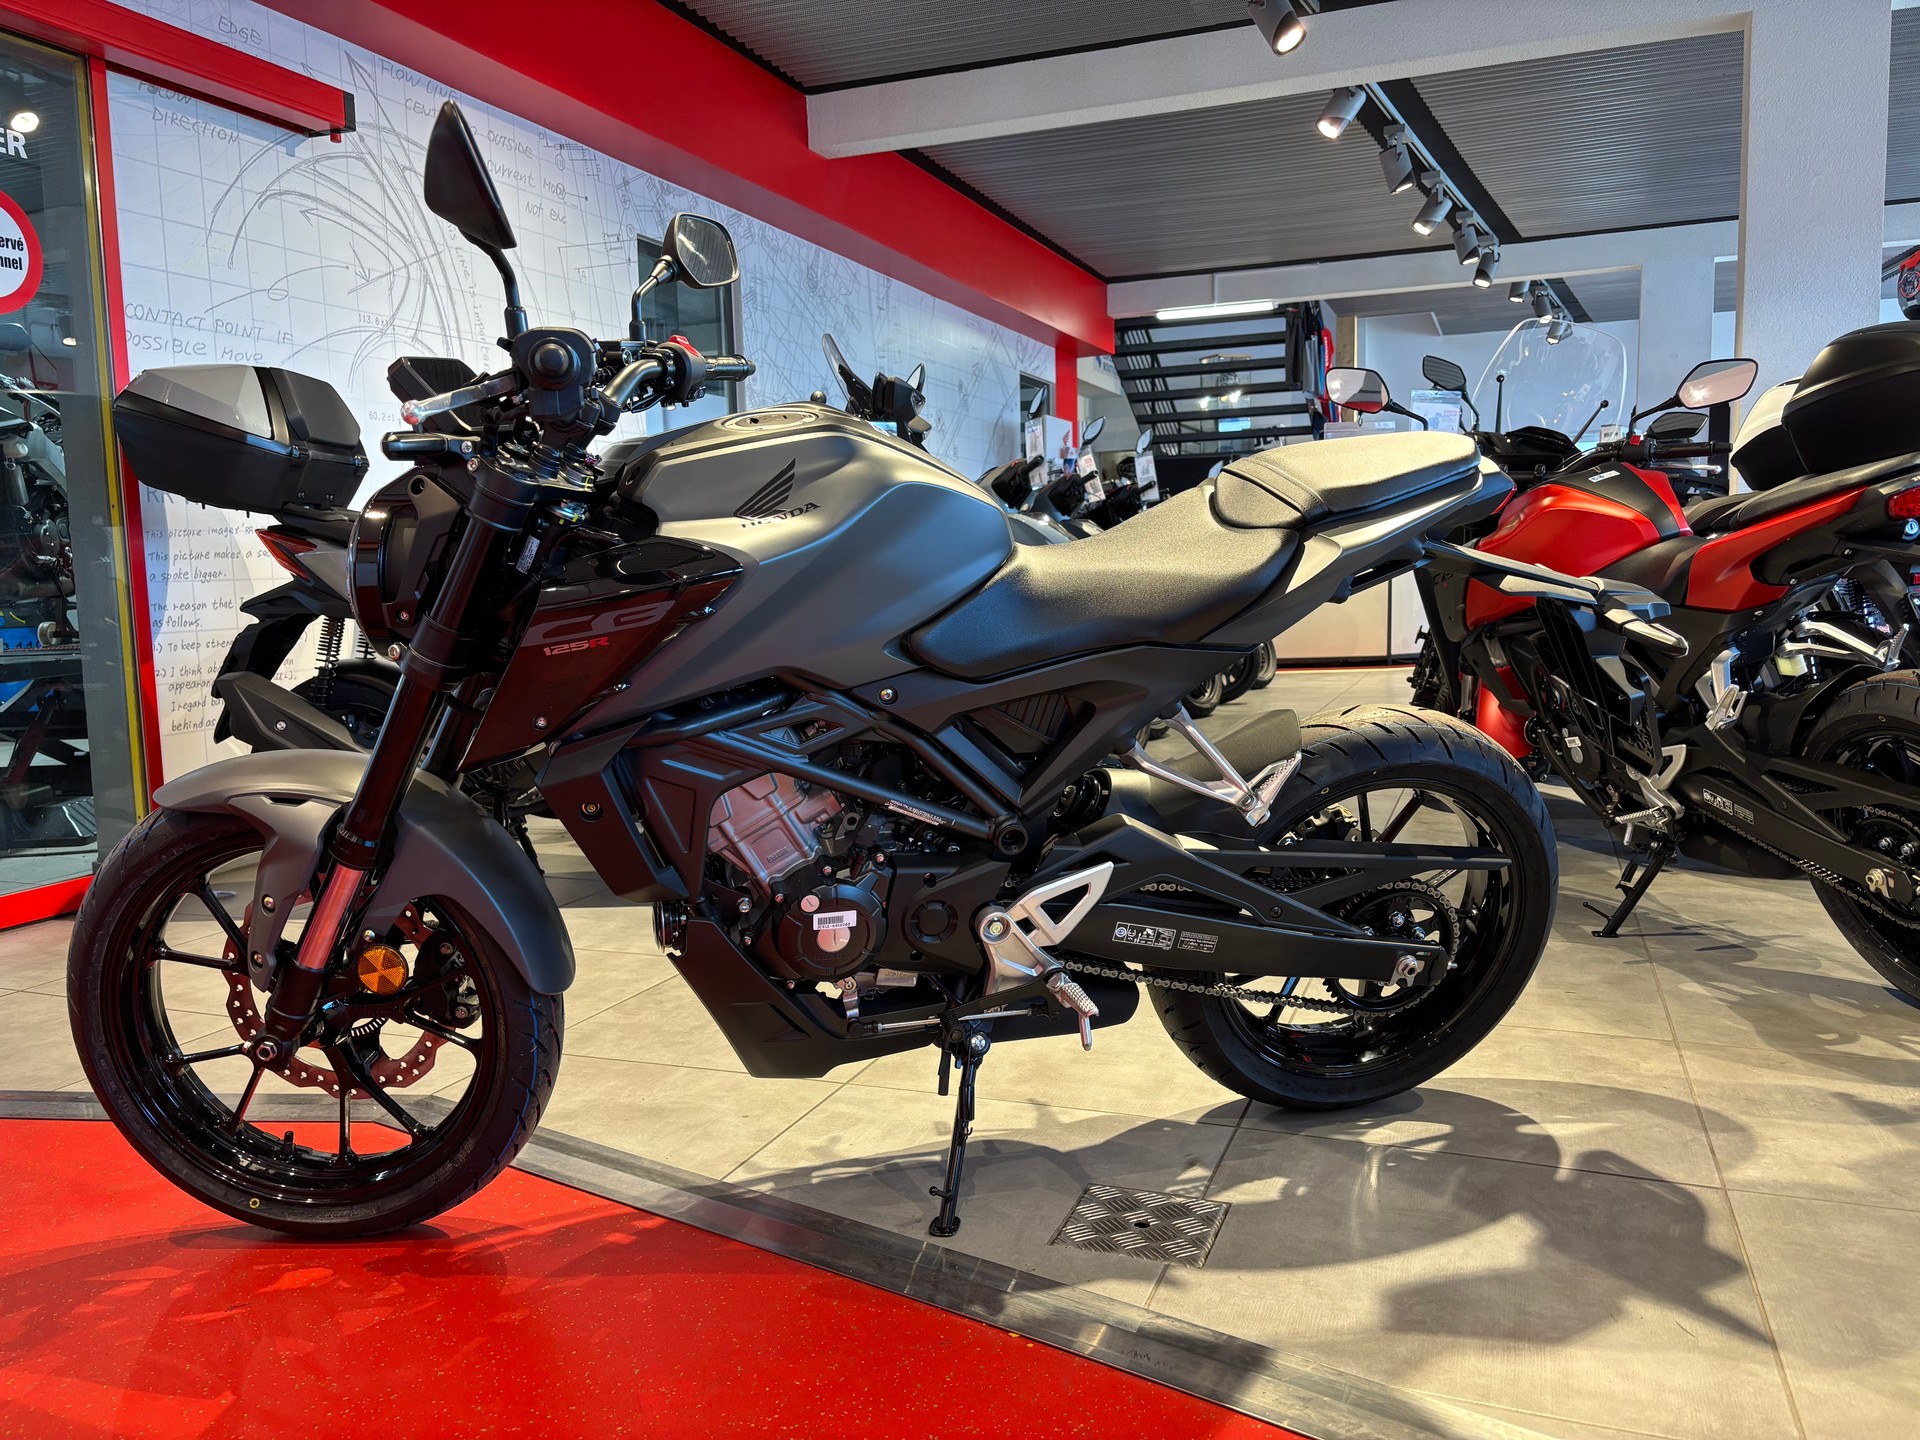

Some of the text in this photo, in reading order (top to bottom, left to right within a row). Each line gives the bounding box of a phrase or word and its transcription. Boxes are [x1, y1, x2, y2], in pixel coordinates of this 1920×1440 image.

[378, 58, 422, 88] FLOW
[152, 106, 239, 145] DIRECTION
[125, 303, 206, 332] CONTACT
[215, 318, 264, 342] POINT
[148, 551, 169, 562] This
[173, 551, 211, 566] picture
[214, 549, 240, 561] makes
[161, 571, 190, 587] spoke
[194, 567, 227, 584] bigger.
[151, 602, 168, 612] The
[173, 601, 208, 612] reason
[212, 596, 235, 610] that
[153, 615, 204, 628] as follows.
[168, 642, 178, 652] To
[181, 639, 202, 654] keep
[543, 636, 609, 656] 125R
[179, 665, 203, 678] think
[171, 718, 204, 732] behind
